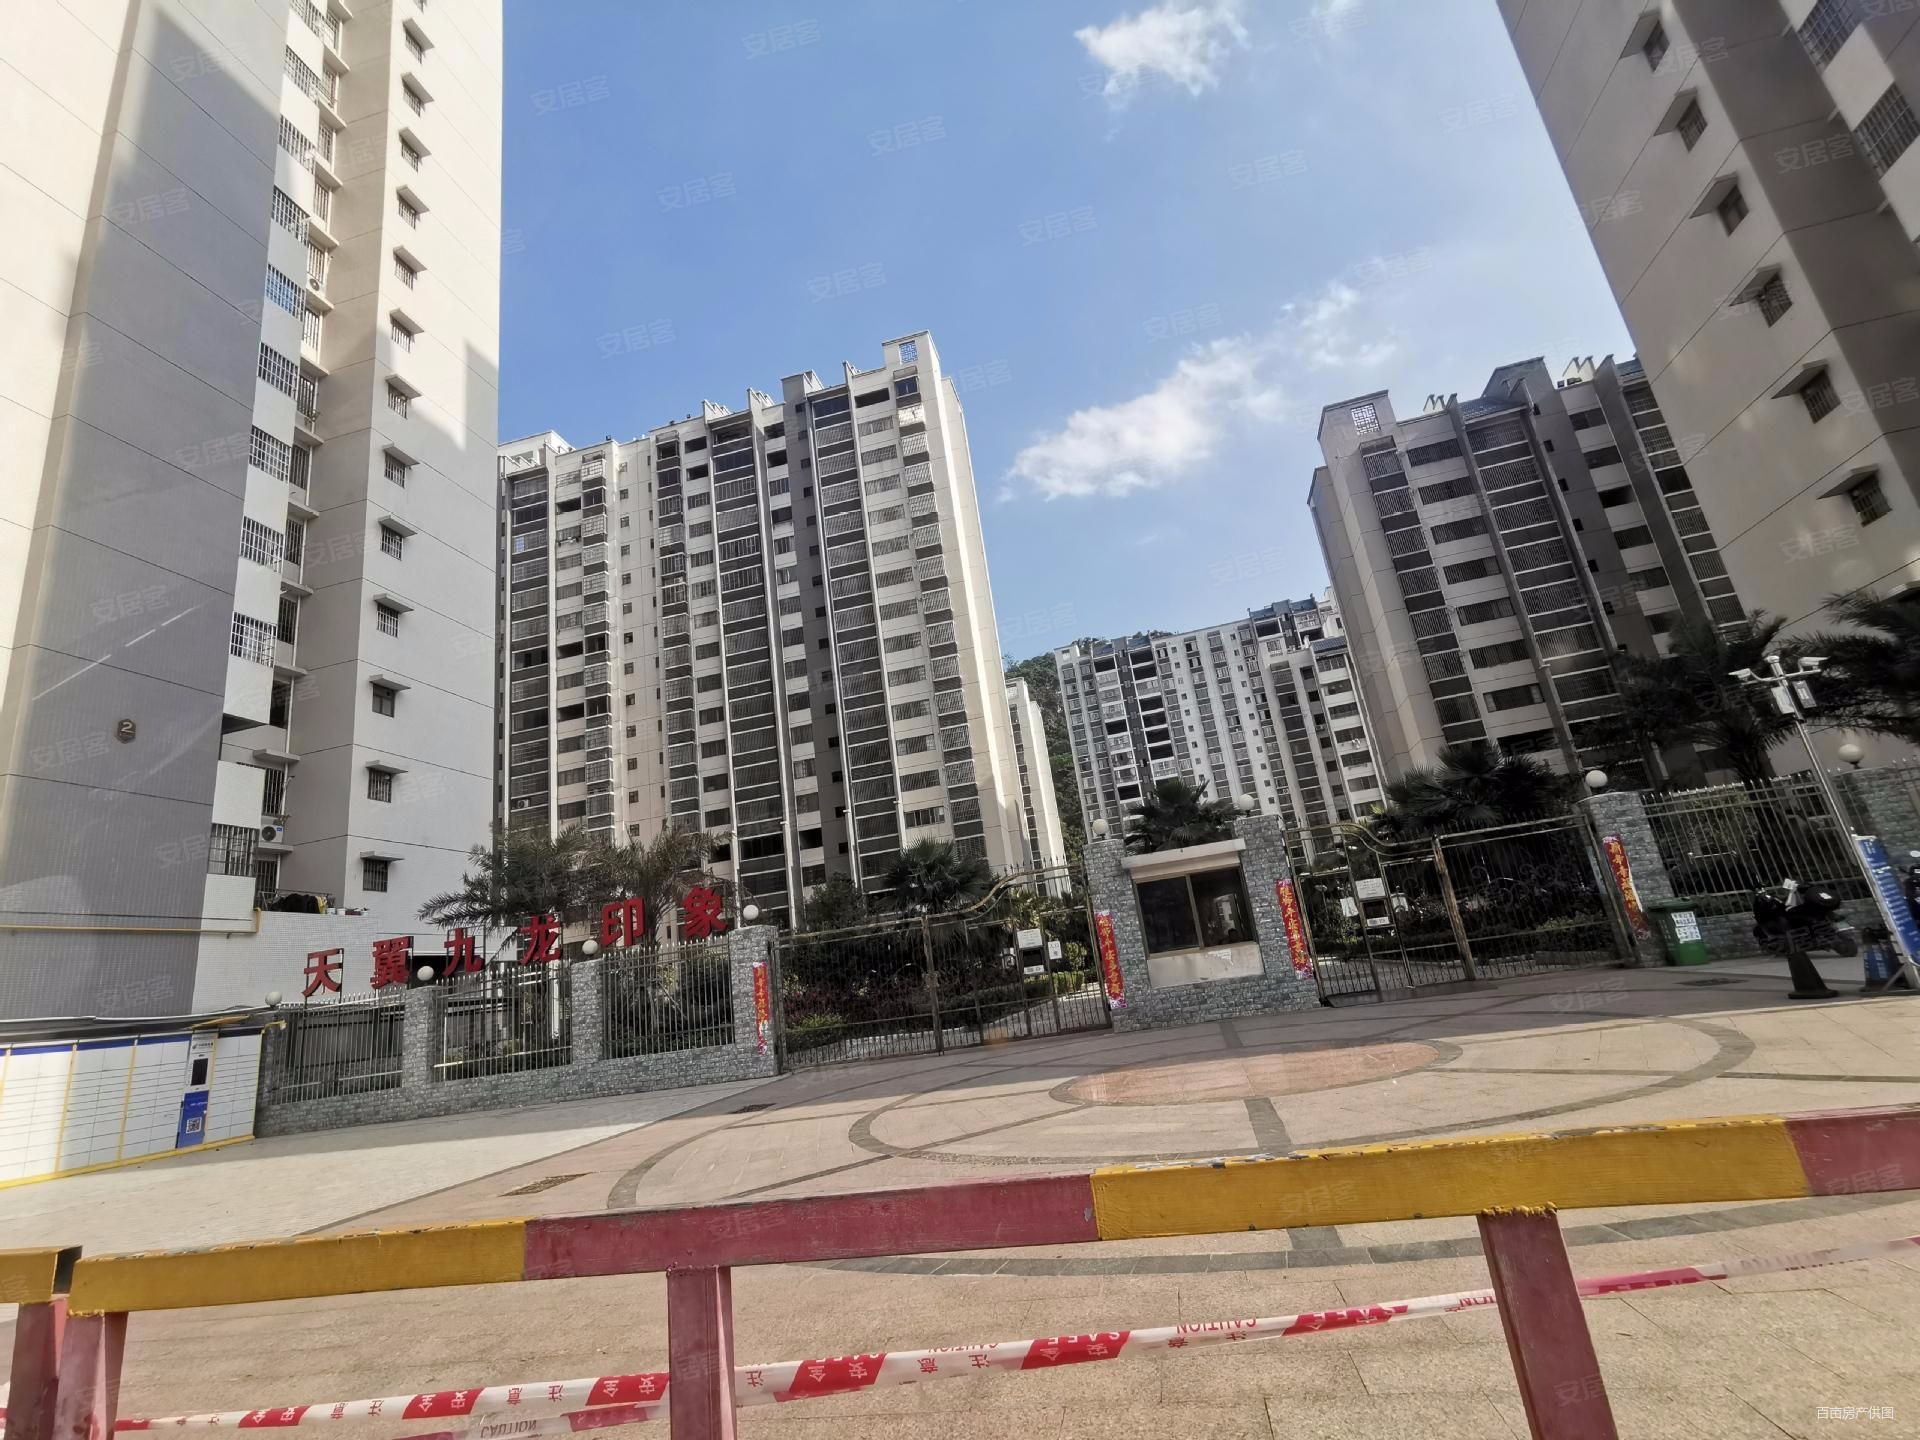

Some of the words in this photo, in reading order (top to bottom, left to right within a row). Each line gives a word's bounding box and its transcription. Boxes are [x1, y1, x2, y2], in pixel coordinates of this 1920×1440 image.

[808, 1362, 868, 1383] 安全
[916, 1354, 991, 1374] 注意
[603, 1376, 656, 1398] 安全
[418, 1390, 468, 1413] 安全
